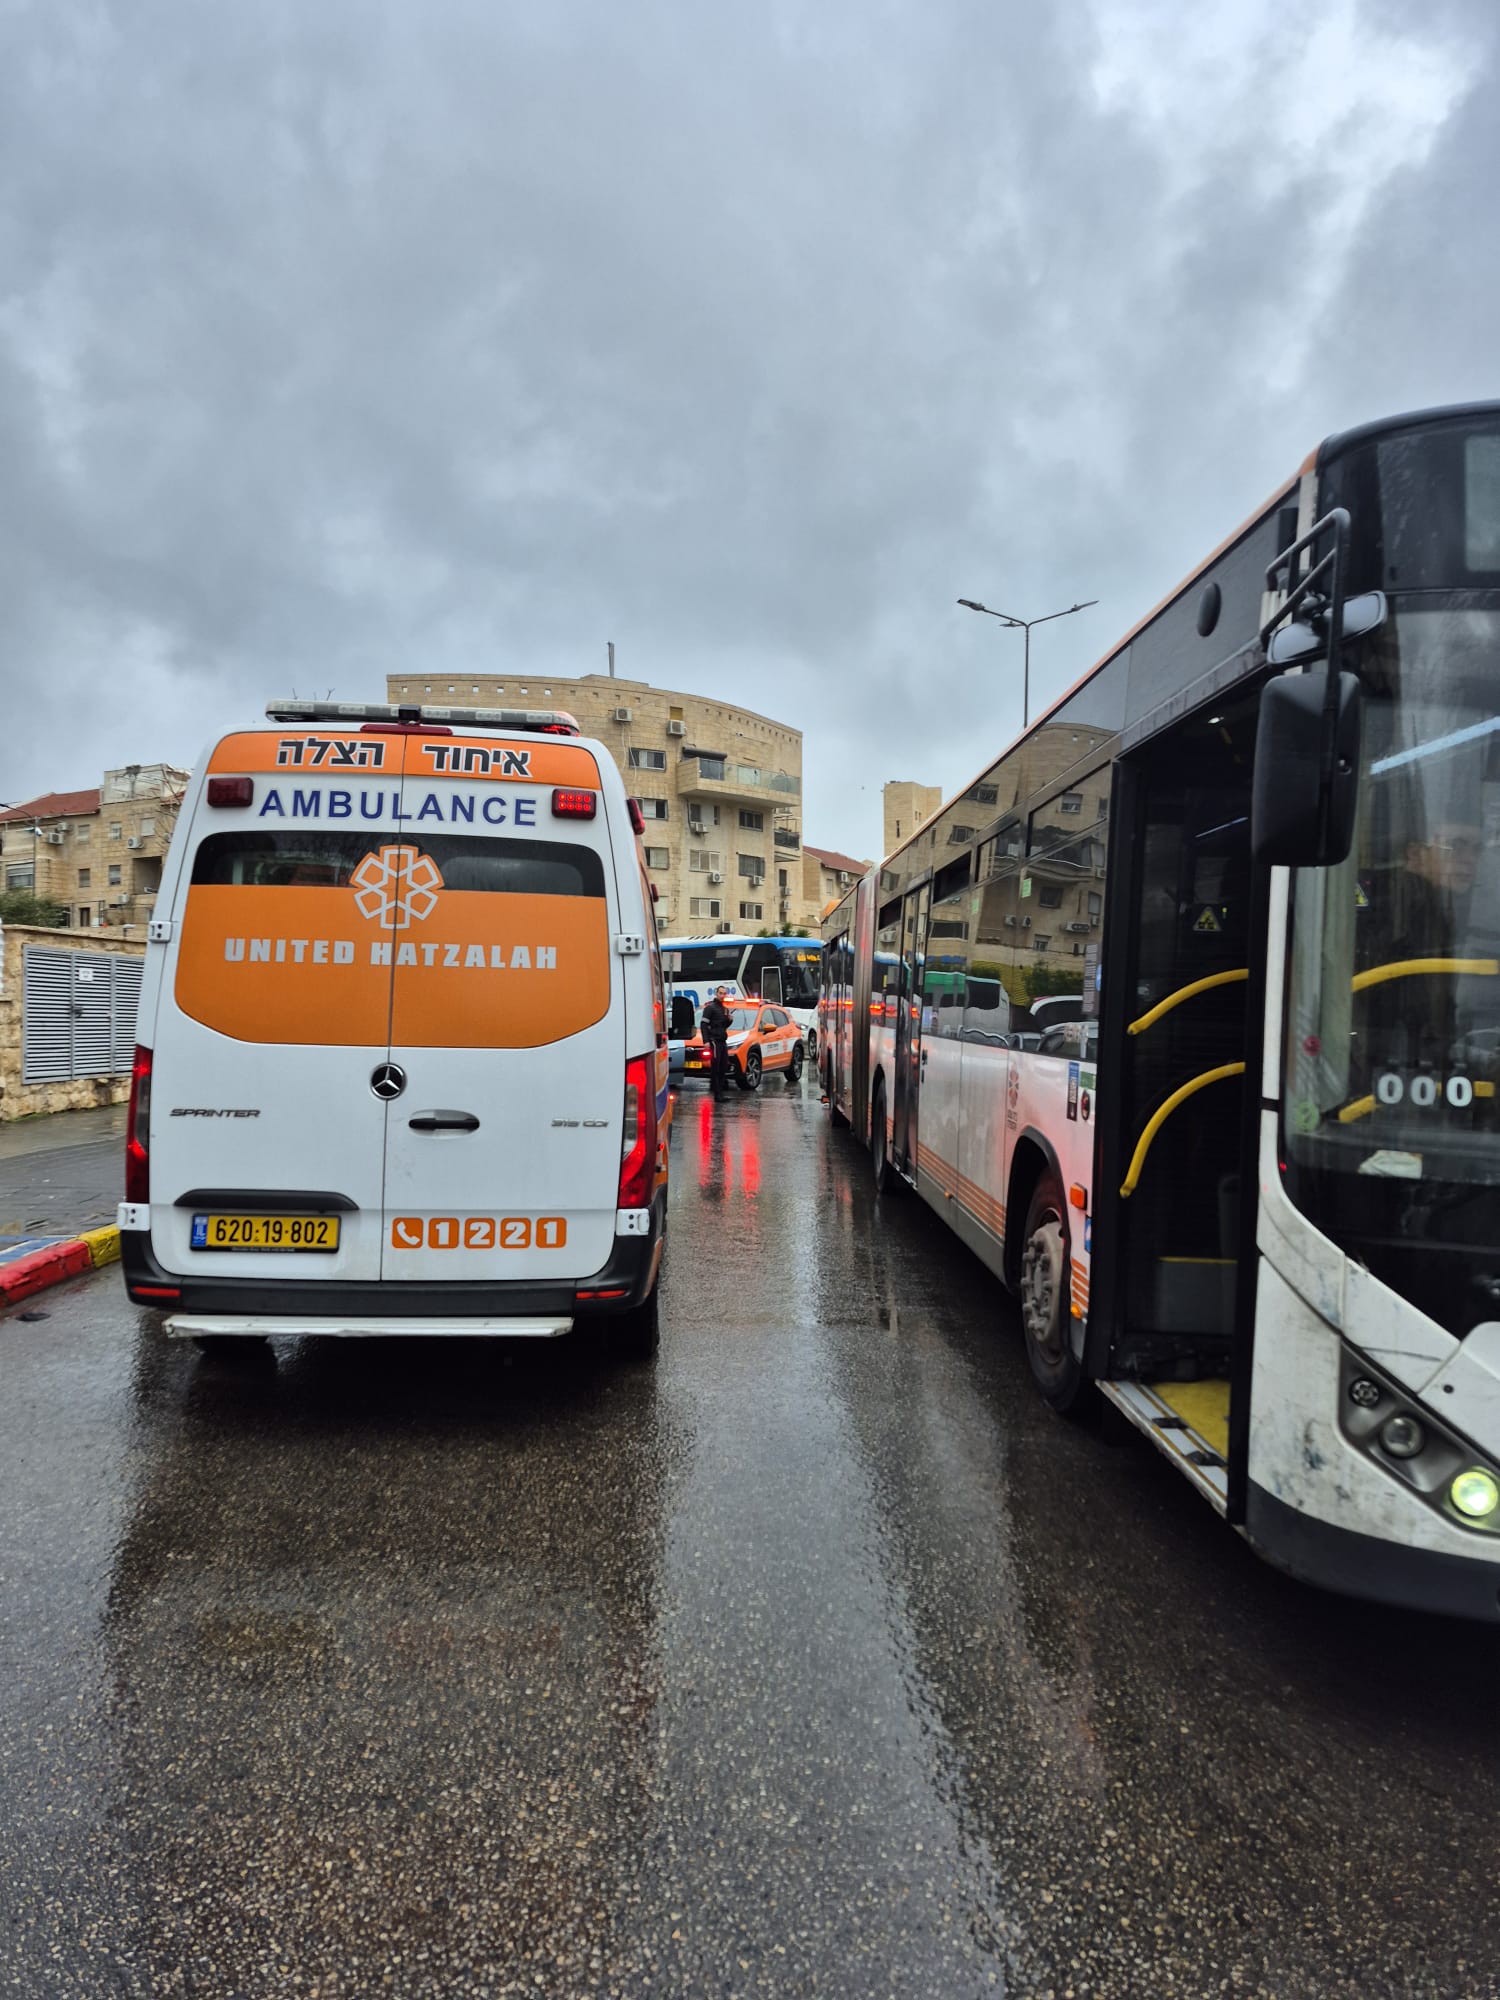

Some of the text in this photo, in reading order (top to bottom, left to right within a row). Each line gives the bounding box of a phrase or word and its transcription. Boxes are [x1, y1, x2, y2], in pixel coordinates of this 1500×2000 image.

[276, 736, 533, 778] איחוד הצלה
[260, 789, 536, 827] AMBULANCE
[224, 938, 557, 969] UNITED HATZALAH
[169, 1108, 261, 1118] SPRINTER
